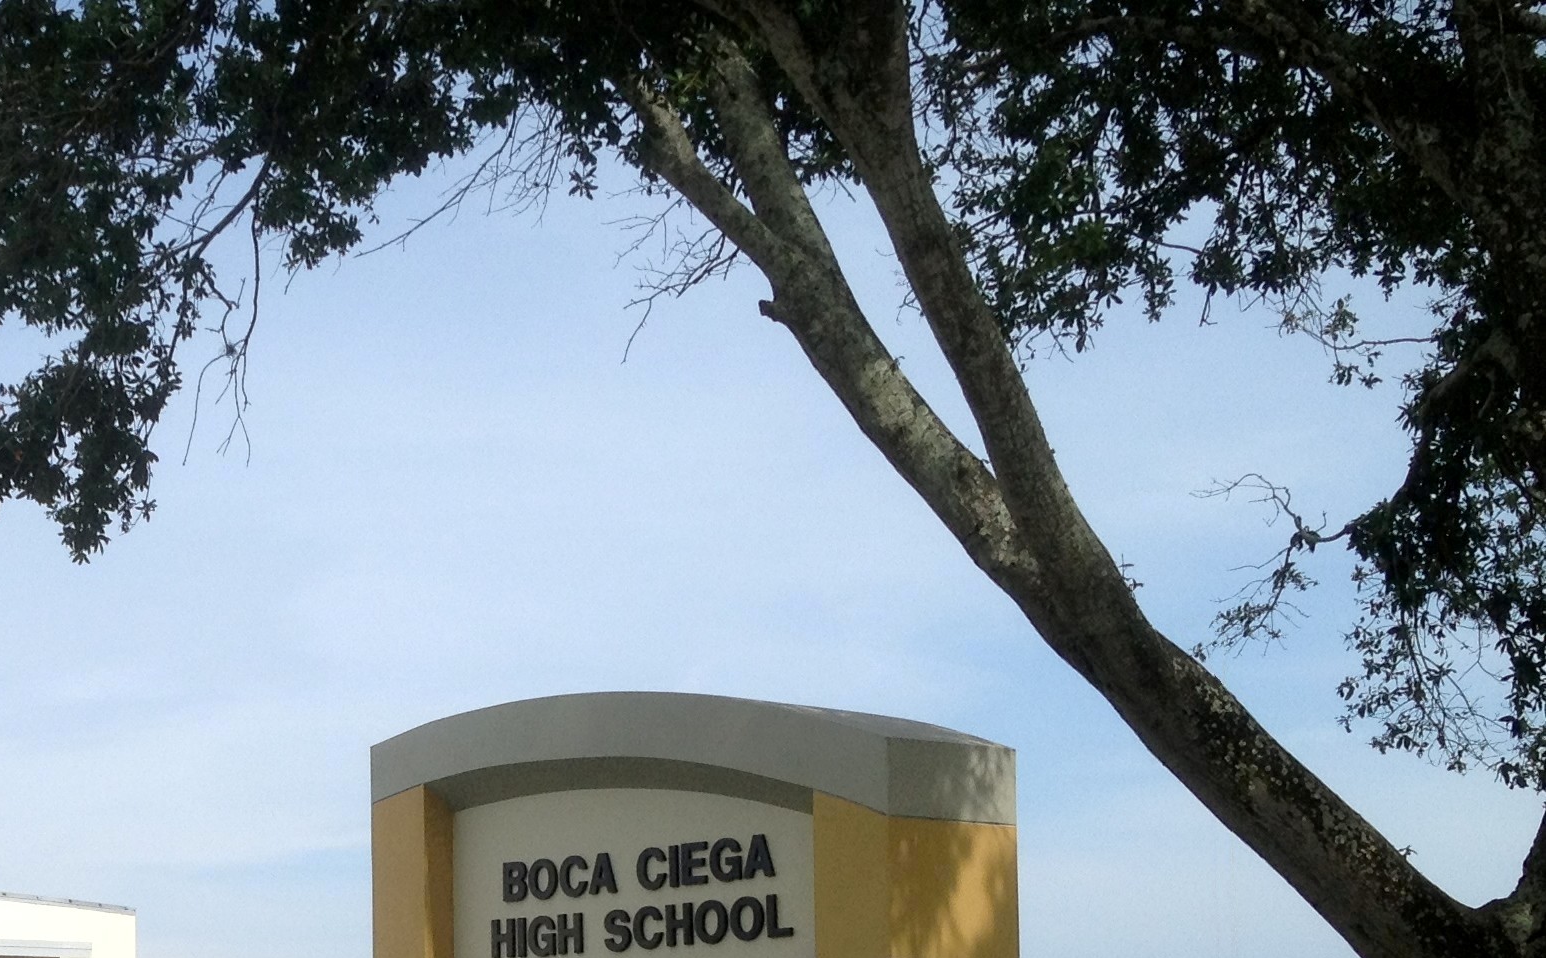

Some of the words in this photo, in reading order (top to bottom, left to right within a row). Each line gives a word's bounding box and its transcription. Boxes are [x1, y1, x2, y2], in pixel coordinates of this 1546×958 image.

[502, 852, 618, 902] BOCA
[636, 833, 777, 892] CIEGA
[603, 894, 795, 953] SCHOOL
